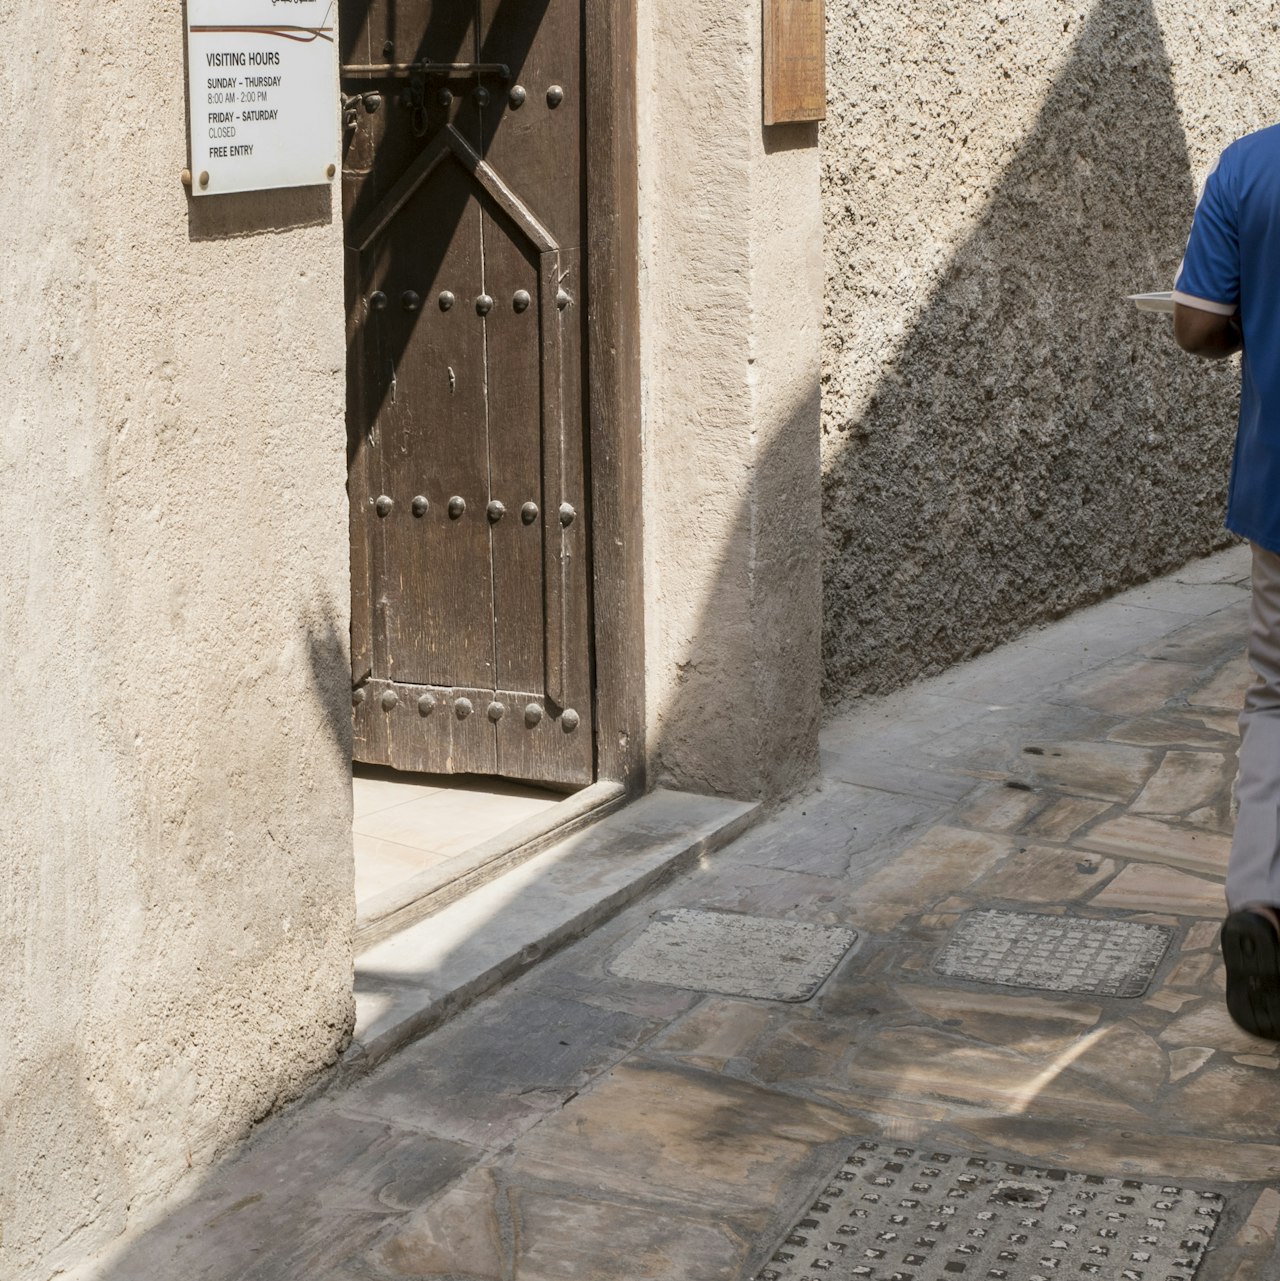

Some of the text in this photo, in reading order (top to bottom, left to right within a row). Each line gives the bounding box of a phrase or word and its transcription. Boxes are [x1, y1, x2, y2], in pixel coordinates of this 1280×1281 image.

[206, 52, 280, 67] VISITING HOURS
[207, 78, 237, 89] SUNDAY
[244, 76, 282, 88] THURSDAY
[208, 93, 224, 104] 8:00
[225, 92, 236, 103] AM
[240, 91, 256, 103] 2:00
[257, 91, 267, 102] PM
[208, 112, 234, 124] FRIDAY
[242, 110, 279, 122] SATURDAY
[208, 126, 236, 139] CLOSED
[209, 144, 254, 158] FREE ENTRY
